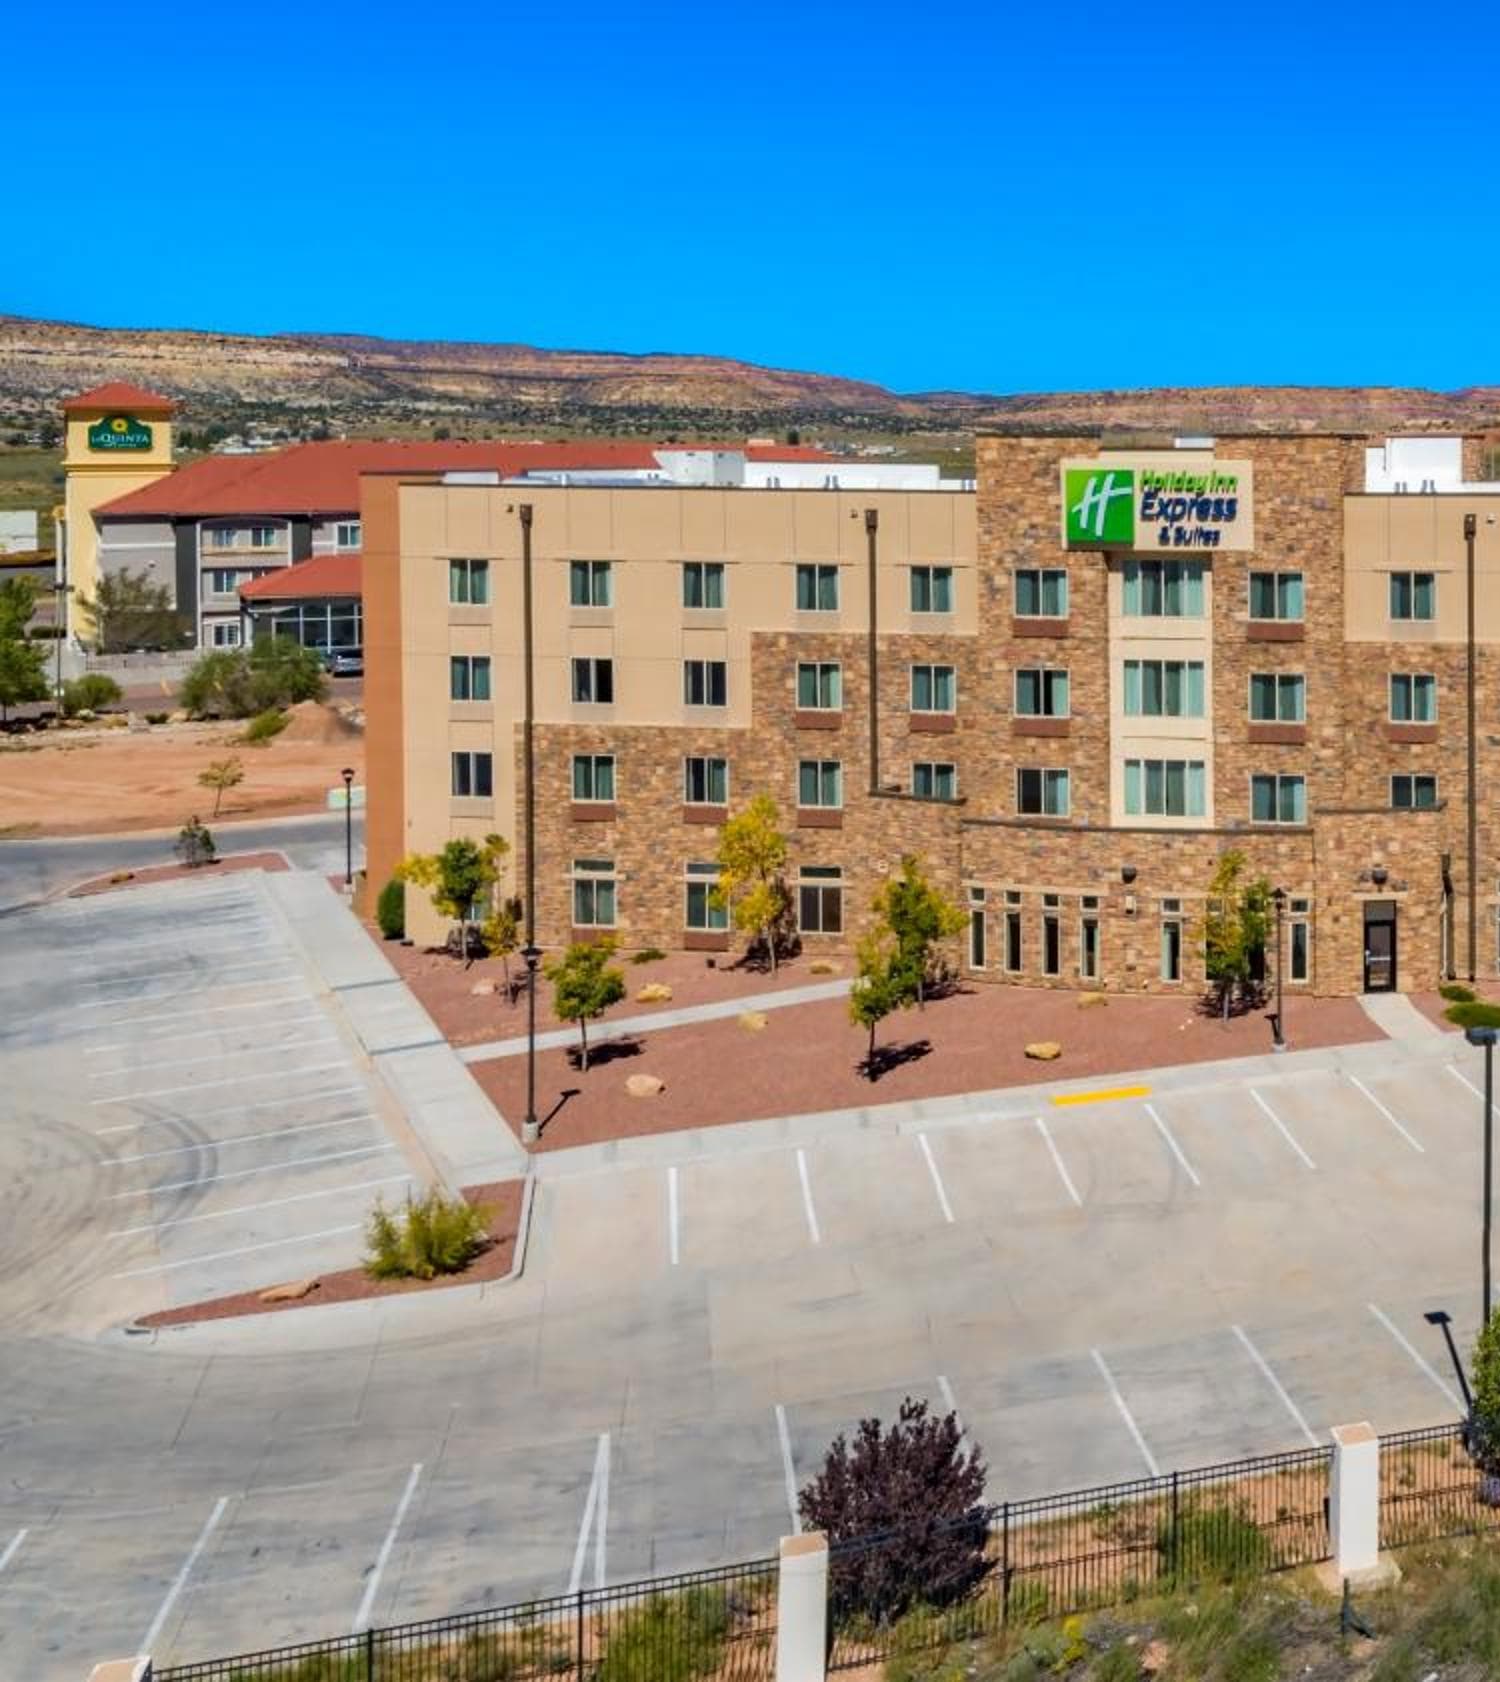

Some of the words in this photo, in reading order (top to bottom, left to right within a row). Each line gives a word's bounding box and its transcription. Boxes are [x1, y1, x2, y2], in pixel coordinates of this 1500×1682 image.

[1140, 470, 1208, 494] Holiday
[1209, 470, 1238, 493] Inn
[1140, 489, 1238, 527] Express
[1174, 526, 1221, 547] Suites
